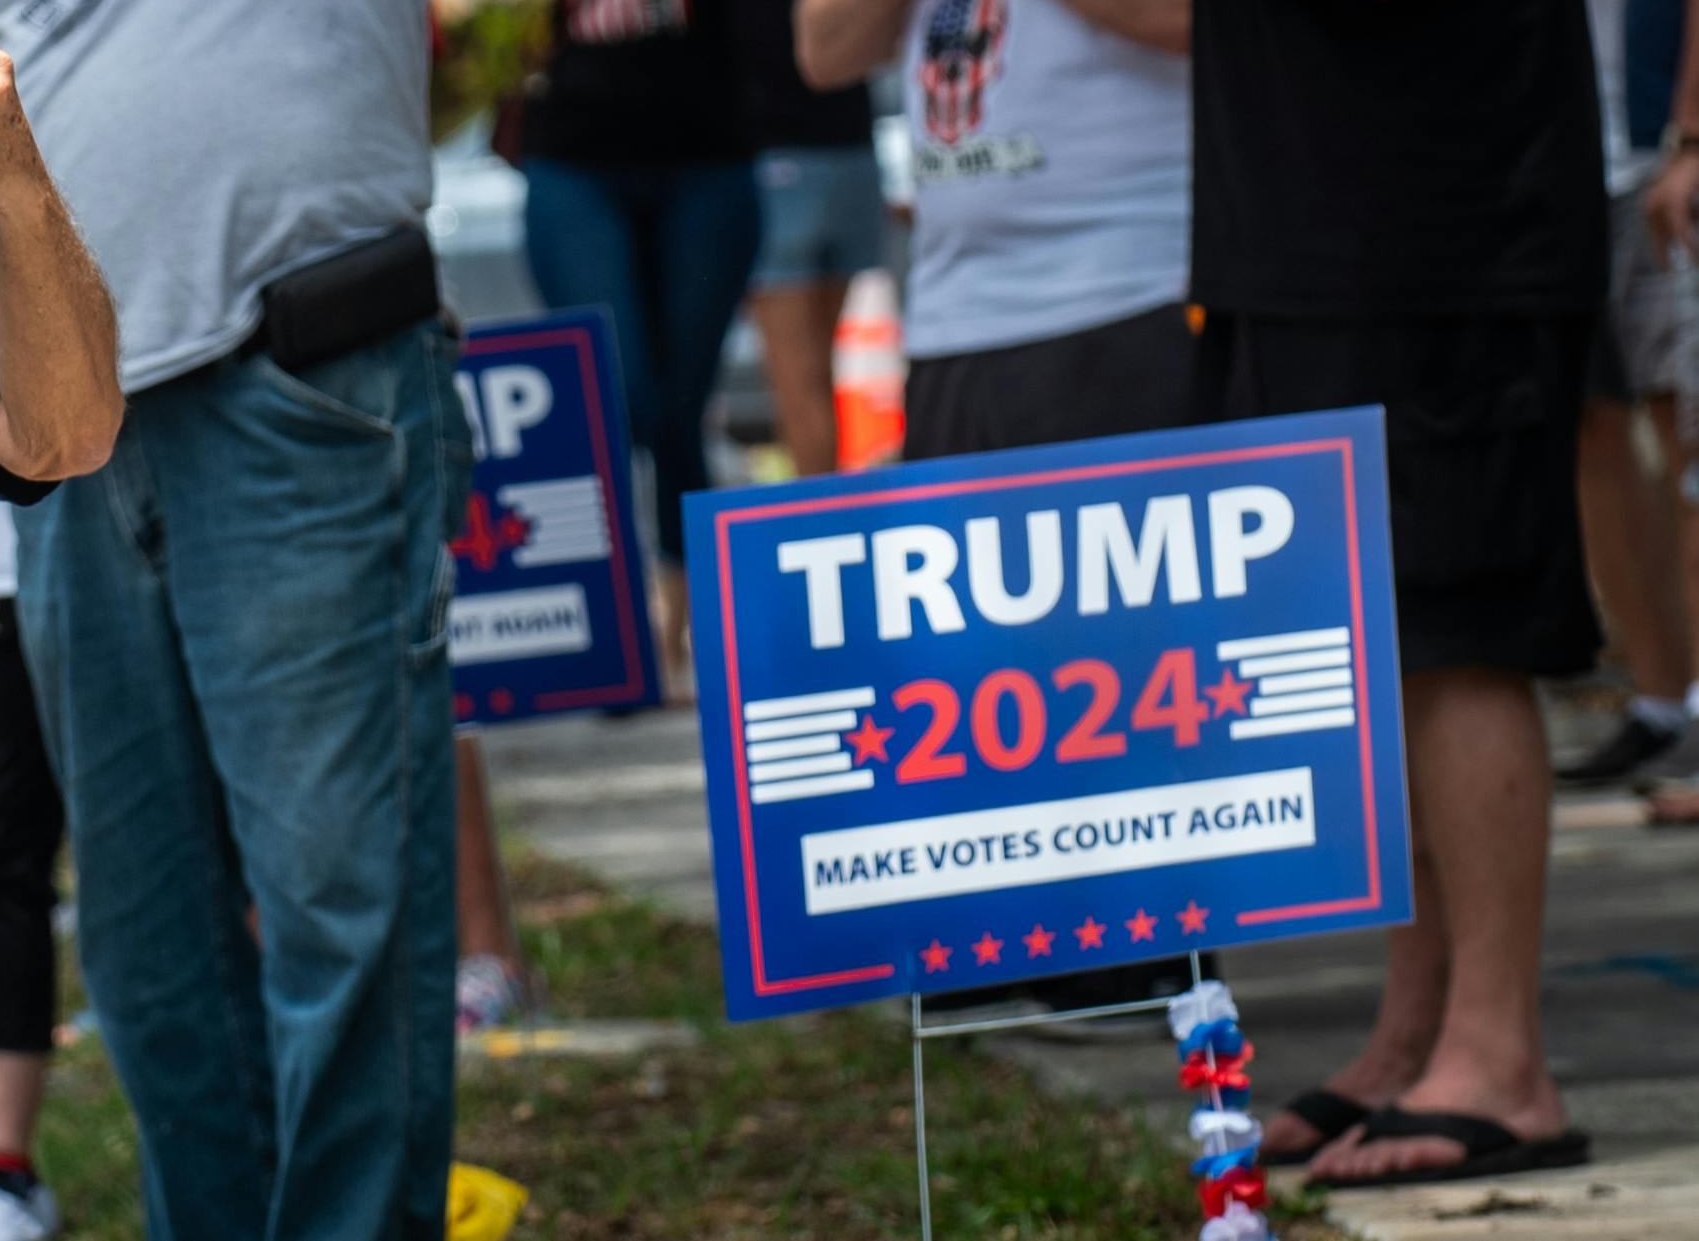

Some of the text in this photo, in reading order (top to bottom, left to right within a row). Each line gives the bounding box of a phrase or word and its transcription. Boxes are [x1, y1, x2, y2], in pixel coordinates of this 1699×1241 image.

[777, 485, 1295, 648] TRUMP
[891, 647, 1209, 784] 2024
[814, 794, 1304, 887] MAKE VOTES COUNT AGAIN
